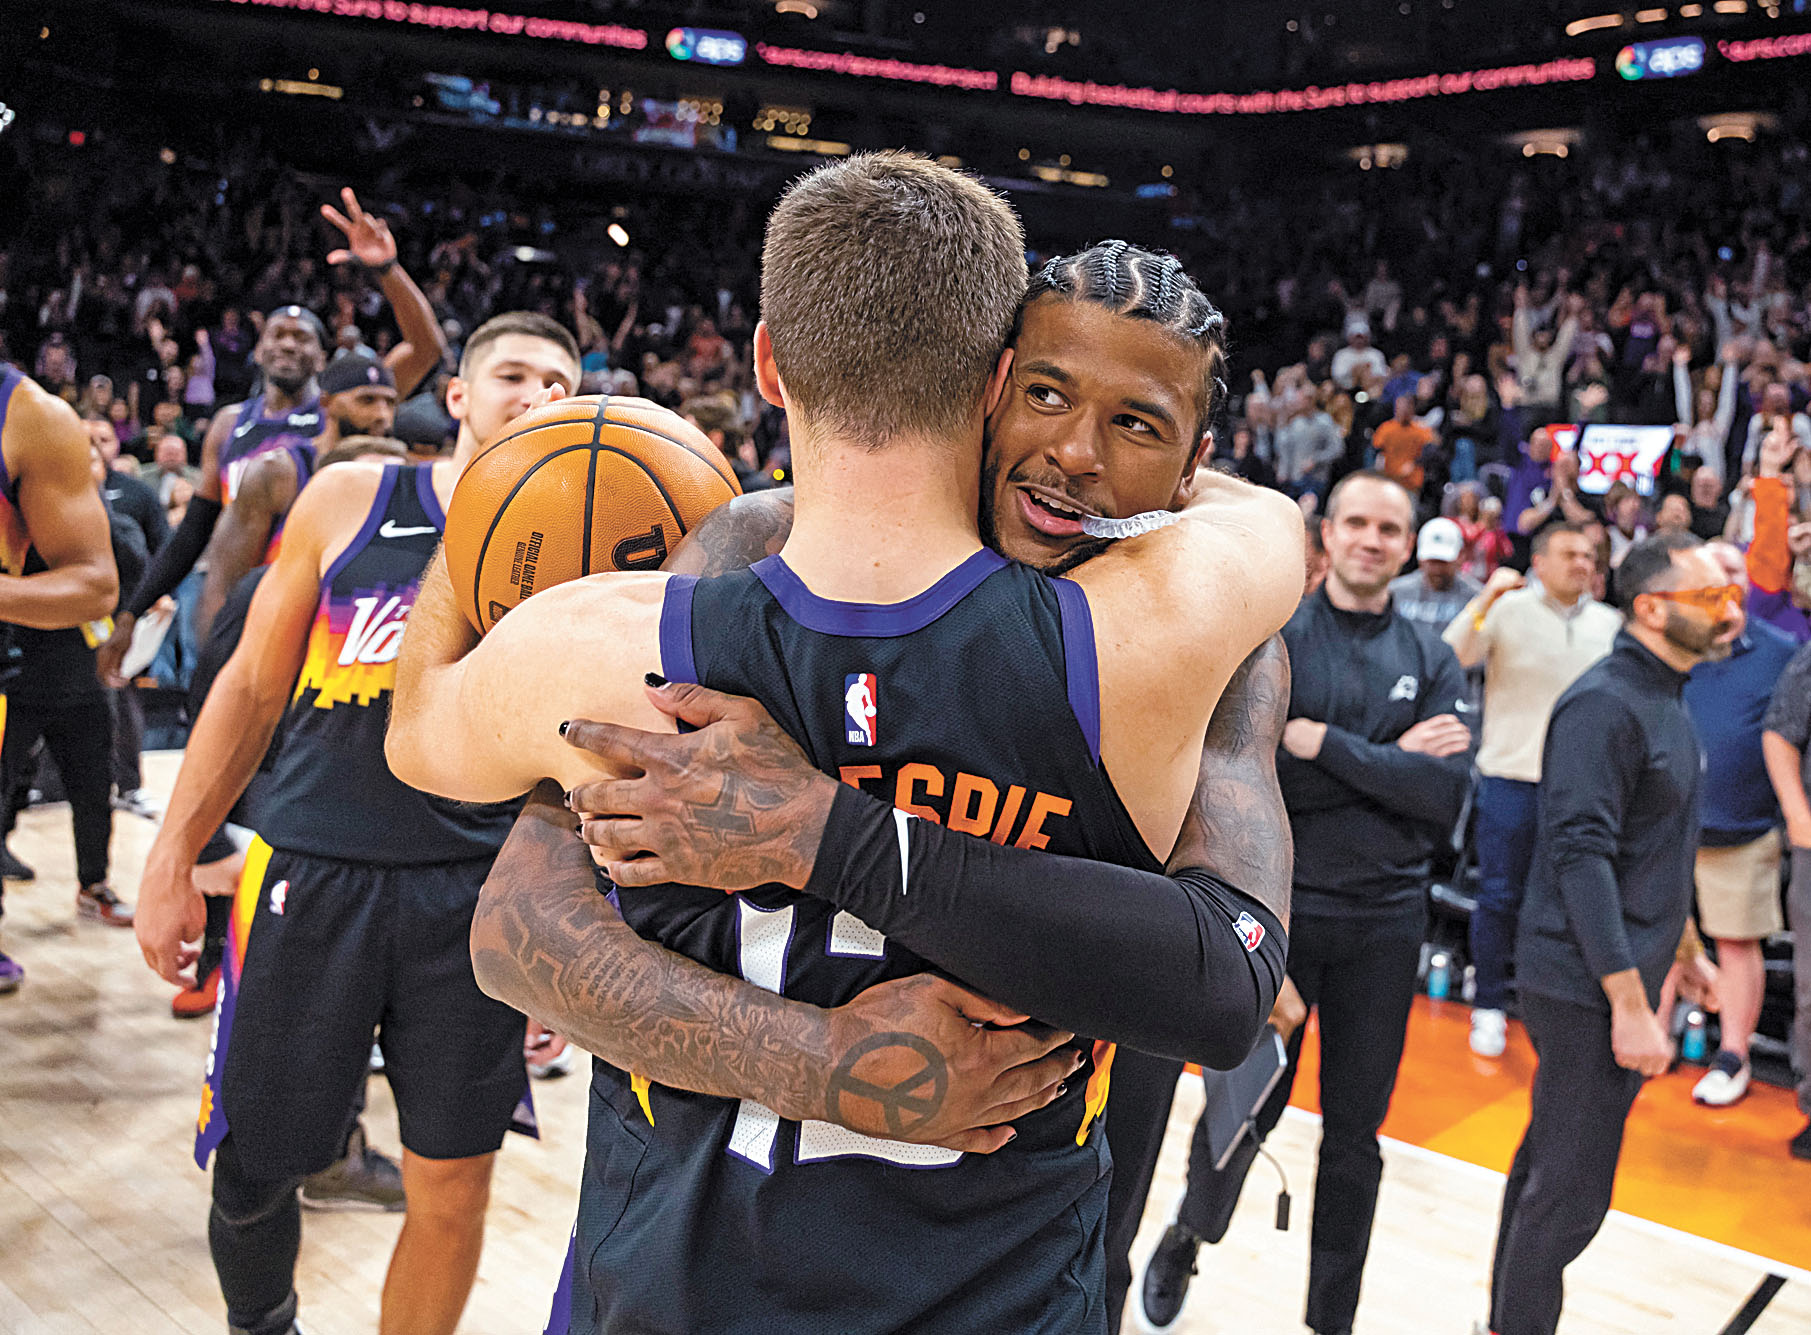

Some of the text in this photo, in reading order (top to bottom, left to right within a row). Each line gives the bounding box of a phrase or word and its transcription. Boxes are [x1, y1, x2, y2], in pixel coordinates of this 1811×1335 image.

[525, 531, 544, 564] OFFICIAL
[522, 563, 537, 585] GAME
[848, 730, 865, 743] NBA
